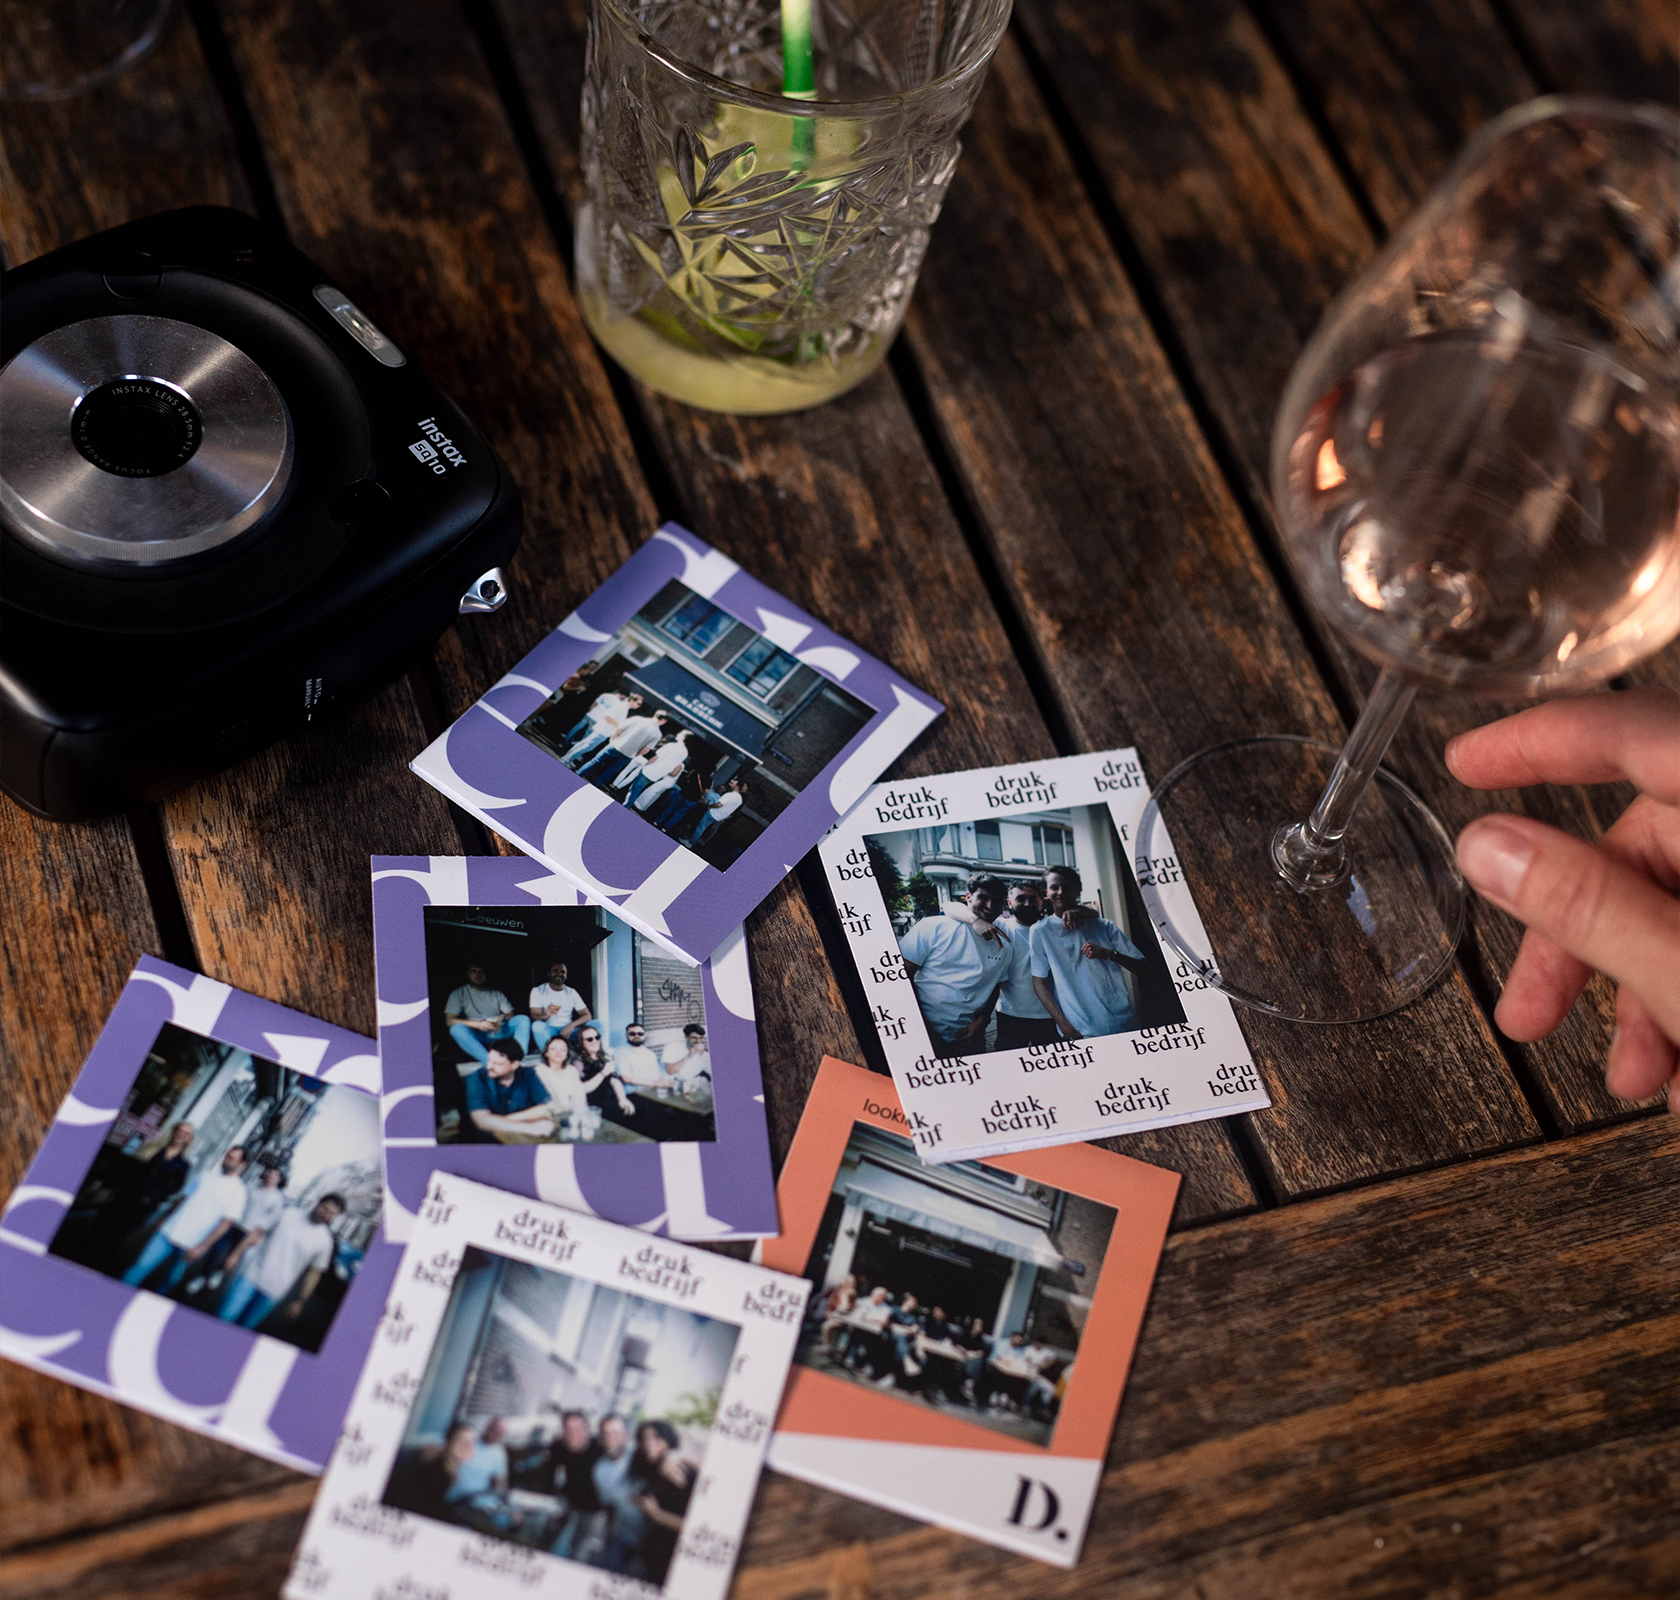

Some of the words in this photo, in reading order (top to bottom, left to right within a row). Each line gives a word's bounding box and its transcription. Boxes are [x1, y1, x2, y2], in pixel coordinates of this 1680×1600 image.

[112, 386, 151, 396] INSTAX
[155, 390, 179, 406] LENS
[417, 416, 467, 467] instax
[1102, 760, 1138, 777] dru
[994, 771, 1046, 792] druk
[1094, 772, 1142, 792] bedr
[884, 786, 937, 808] druk
[985, 782, 1057, 808] bedrijf
[876, 798, 949, 823] bedrijf
[466, 908, 524, 929] Leeuwen
[843, 914, 872, 937] ijf
[877, 1017, 907, 1040] ijf
[1131, 1027, 1206, 1055] bedrijf
[1019, 1046, 1095, 1073] bedrijf
[1215, 1063, 1256, 1081] dru
[905, 1062, 982, 1089] bedrijf
[1207, 1076, 1261, 1097] bedr
[1104, 1077, 1158, 1100] druk
[863, 1098, 908, 1125] looki
[990, 1095, 1044, 1117] druk
[1095, 1088, 1171, 1116] bedrijf
[981, 1107, 1058, 1134] bedrijf
[912, 1123, 943, 1147] ijf
[513, 1209, 569, 1239] druk
[495, 1219, 580, 1261] bedrijf
[637, 1246, 692, 1274] druk
[619, 1256, 703, 1298] bedrijf
[1005, 1474, 1068, 1541] D.
